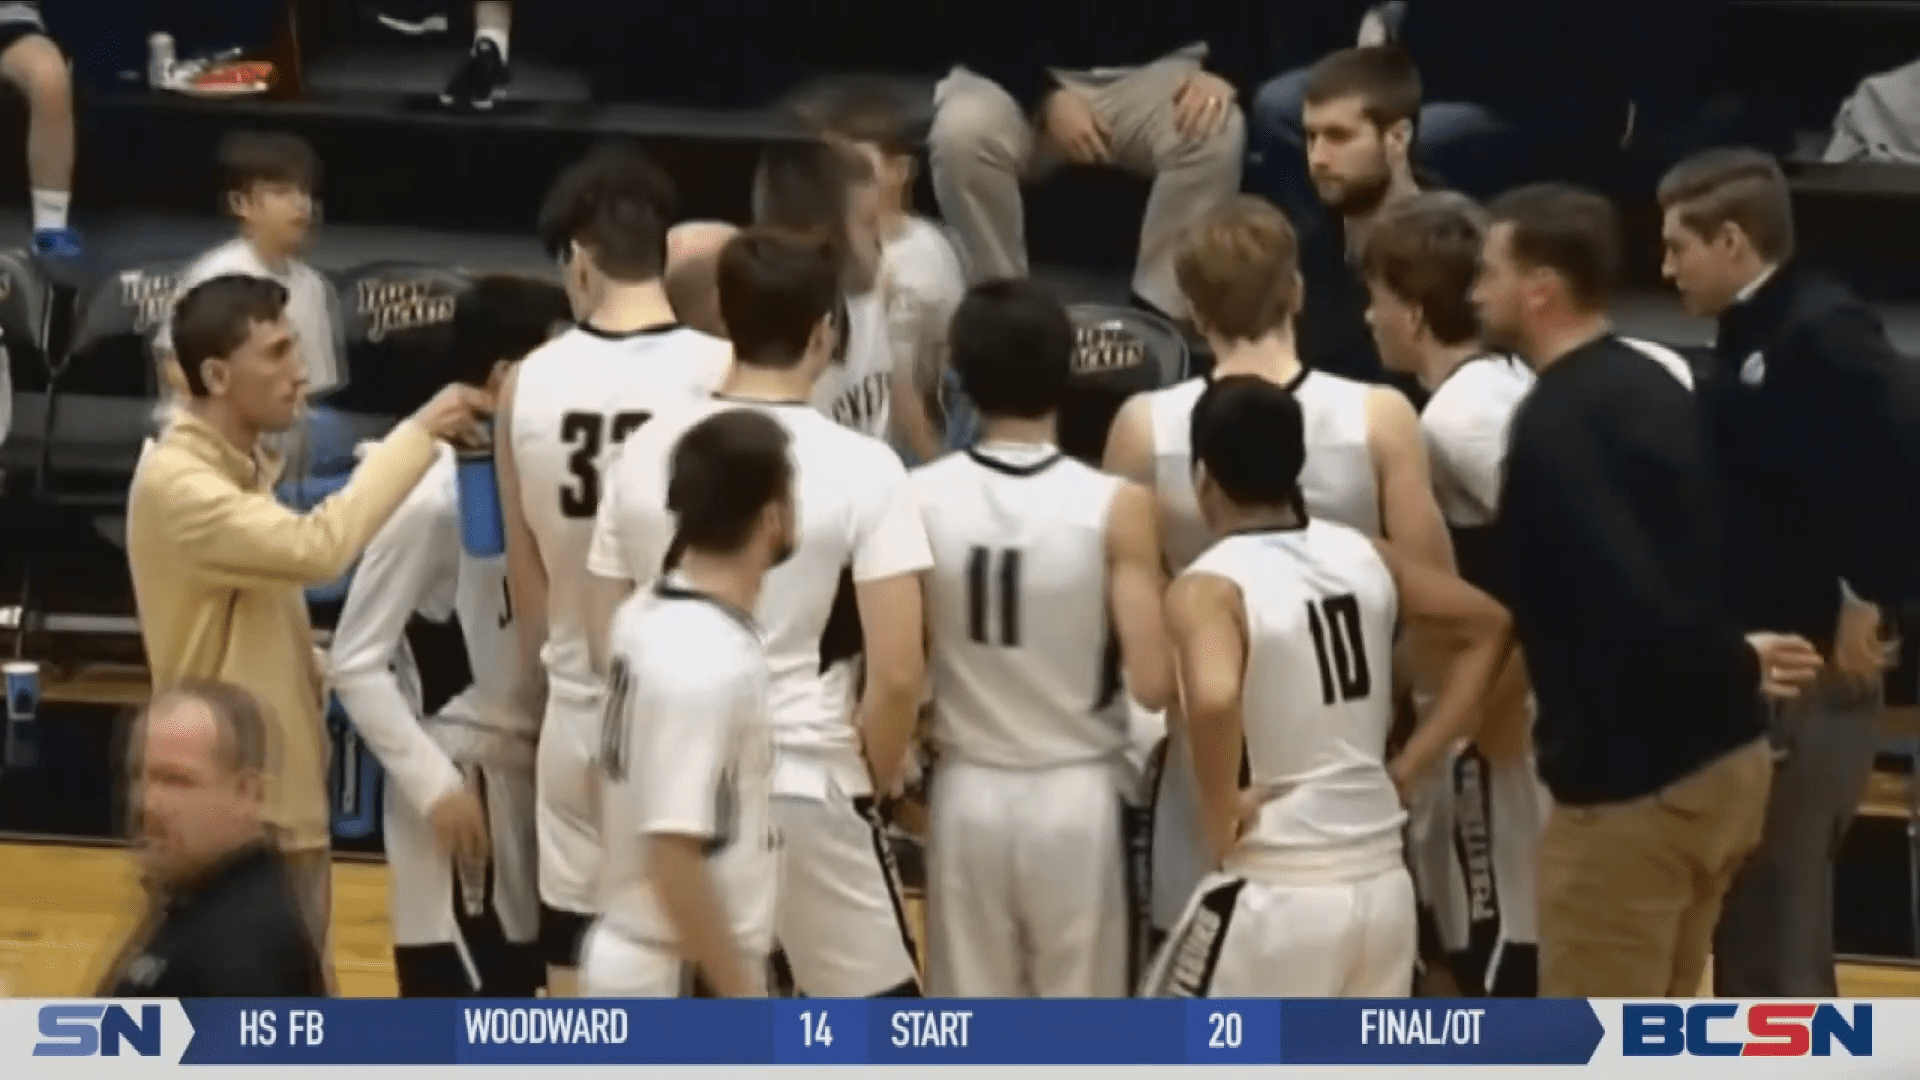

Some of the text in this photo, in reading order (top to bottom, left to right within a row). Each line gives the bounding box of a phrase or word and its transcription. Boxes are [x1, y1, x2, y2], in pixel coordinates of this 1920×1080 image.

[559, 408, 654, 519] 3
[965, 544, 1022, 649] 11
[1305, 592, 1370, 705] 10
